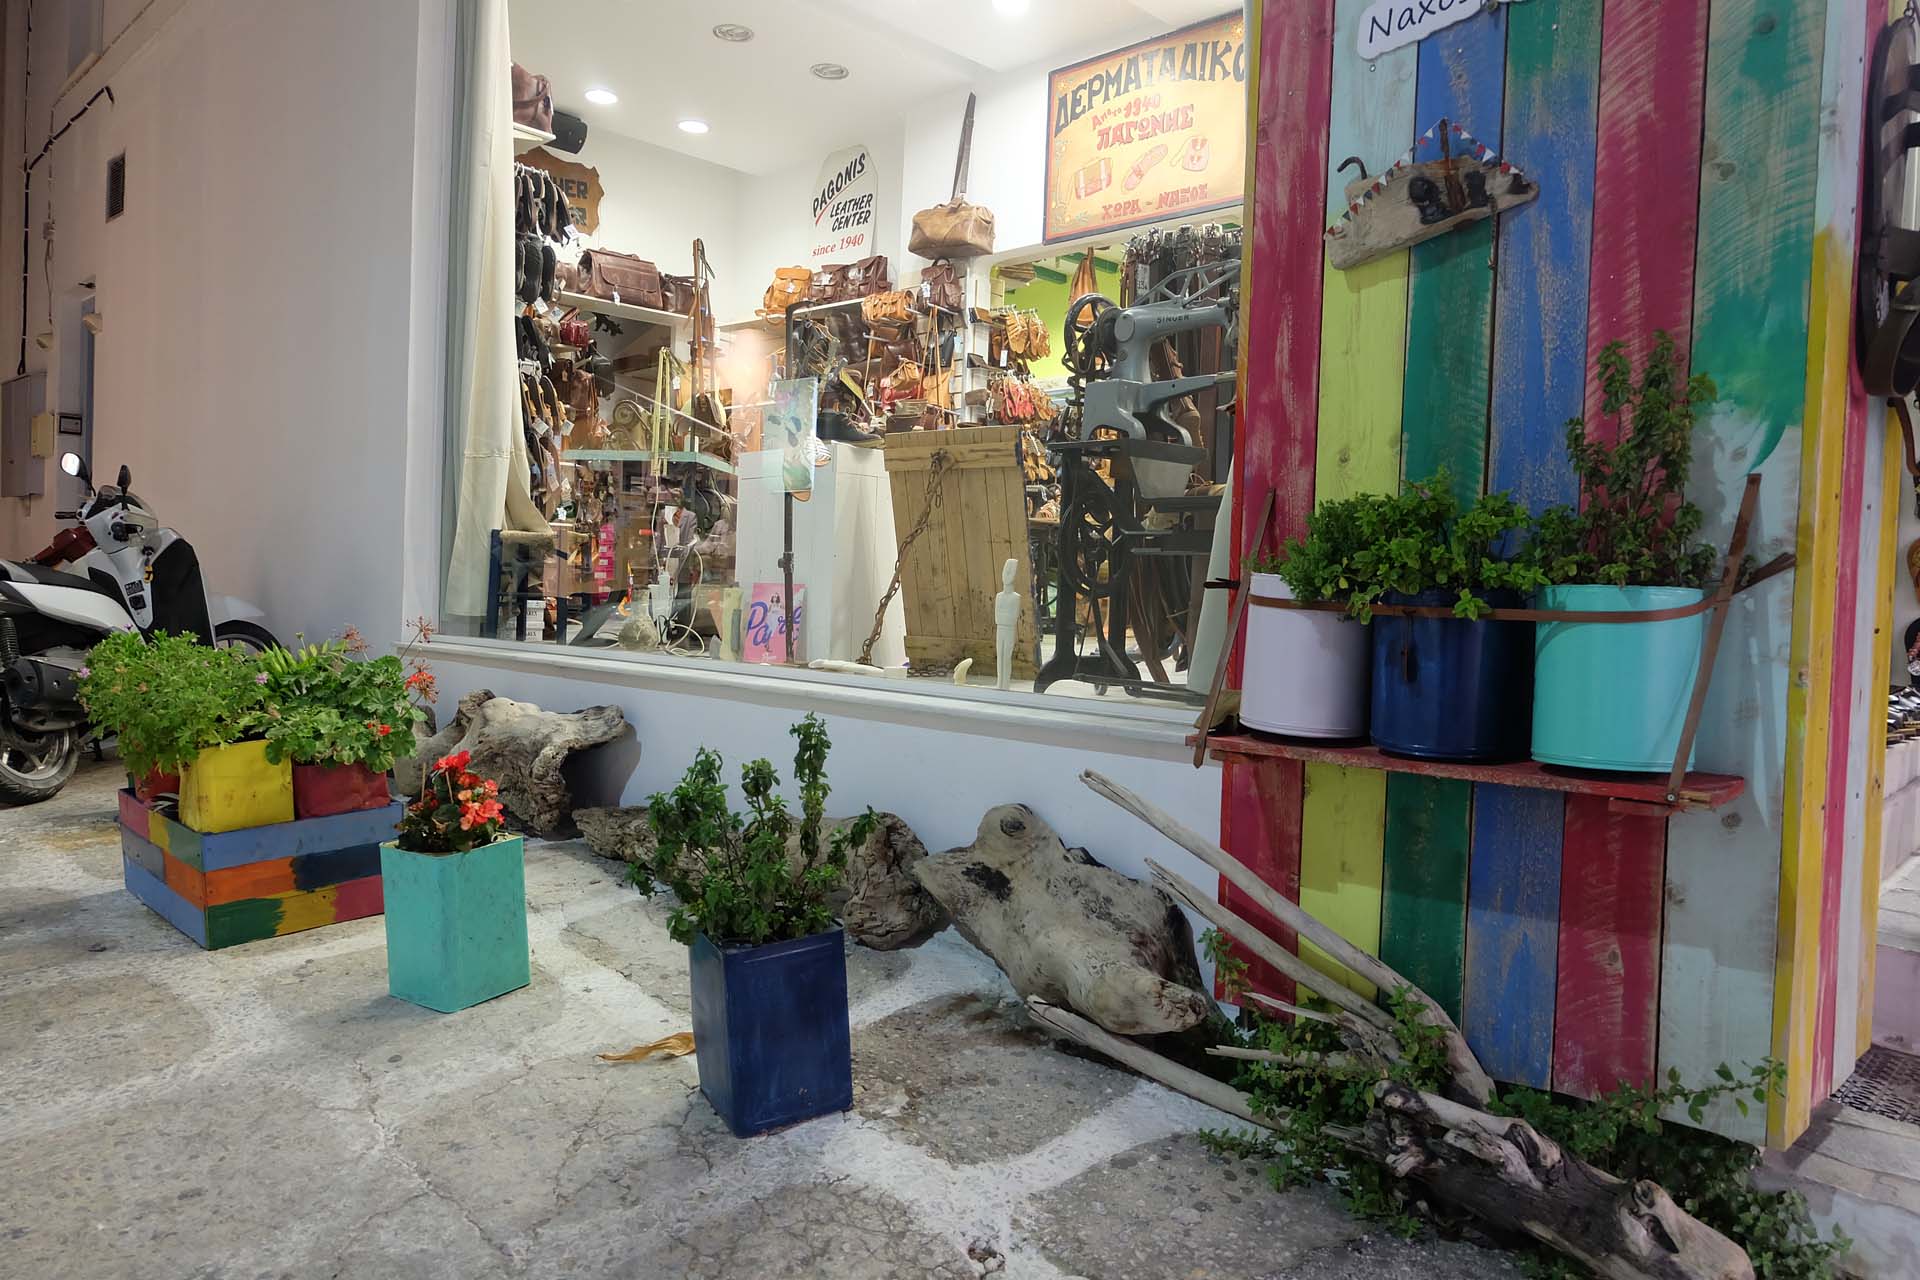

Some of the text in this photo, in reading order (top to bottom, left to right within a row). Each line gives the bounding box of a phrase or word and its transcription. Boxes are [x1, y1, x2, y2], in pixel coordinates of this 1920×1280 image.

[1123, 93, 1161, 119] 1940
[813, 152, 866, 218] PAGONIS
[830, 193, 874, 218] LEATHER
[832, 209, 872, 232] CENTER
[812, 233, 865, 257] since 1940
